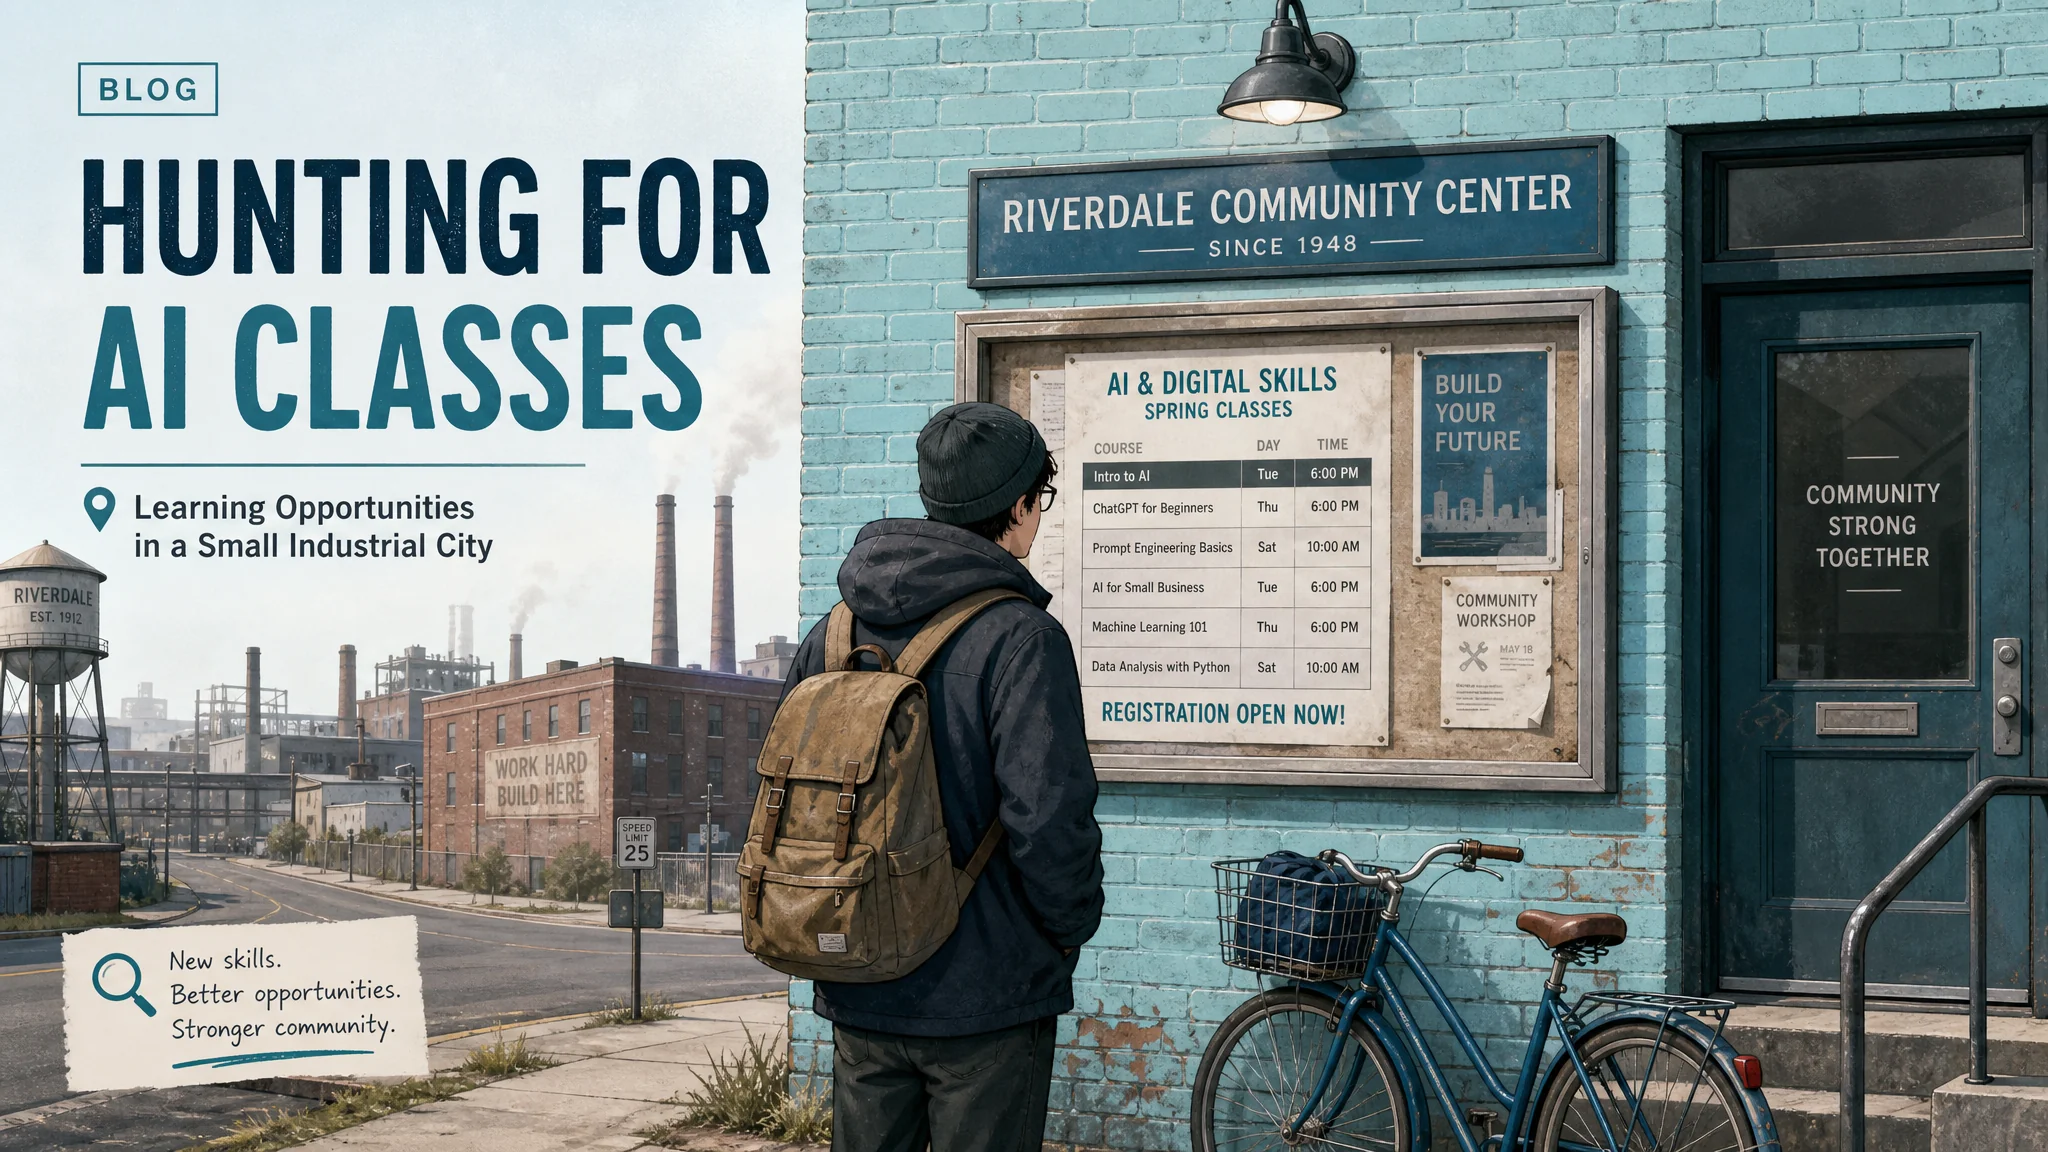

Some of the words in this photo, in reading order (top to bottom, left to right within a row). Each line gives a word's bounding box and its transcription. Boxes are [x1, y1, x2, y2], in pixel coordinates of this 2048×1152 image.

[1003, 190, 1194, 235] RIVERDALE
[1210, 180, 1423, 224] COMMUNITY
[1435, 173, 1572, 214] CENTER
[1208, 238, 1283, 258] SINCE
[1296, 234, 1358, 255] 1948
[1107, 373, 1129, 396] AI
[1137, 371, 1153, 395] &
[1162, 368, 1250, 394] DIGITAL
[1258, 366, 1338, 391] SKILLS
[1435, 373, 1502, 395] BUILD
[1144, 402, 1210, 420] SPRING
[1216, 399, 1293, 418] CLASSES
[1435, 402, 1496, 423] YOUR
[1094, 442, 1143, 455] COURSE
[1256, 439, 1281, 451] DAY
[1317, 438, 1348, 451] TIME
[1435, 430, 1521, 452] FUTURE
[1094, 470, 1121, 482] Intro
[1123, 471, 1135, 482] to
[1138, 470, 1150, 482] AI
[1257, 468, 1279, 480] Tue
[1310, 467, 1337, 479] 6:00
[1341, 467, 1359, 479] PM
[1806, 483, 1941, 504] COMMUNITY
[1093, 502, 1138, 514] ChatGPT
[1142, 502, 1156, 513] for
[1160, 502, 1214, 516] Beginners
[1257, 501, 1278, 513] Thu
[1311, 500, 1337, 512] 6:00
[1341, 500, 1359, 512] PM
[1829, 515, 1916, 536] STRONG
[1092, 543, 1131, 556] Prompt
[1134, 542, 1196, 556] Engineering
[1199, 541, 1233, 554] Basics
[1258, 541, 1276, 553] Sat
[1307, 540, 1338, 552] 10:00
[1341, 540, 1360, 552] AM
[1816, 547, 1930, 567] TOGETHER
[1092, 582, 1103, 593] AI
[1107, 582, 1121, 593] for
[1125, 582, 1153, 593] Small
[1158, 582, 1204, 593] Business
[1257, 581, 1278, 593] Tue
[1311, 581, 1337, 592] 6:00
[1341, 581, 1359, 592] PM
[14, 587, 93, 607] RIVERDALE
[1456, 593, 1538, 607] COMMUNITY
[30, 611, 55, 623] EST.
[60, 612, 83, 624] 1912
[1457, 613, 1536, 627] WORKSHOP
[1092, 621, 1136, 633] Machine
[1140, 621, 1186, 635] Learning
[1190, 621, 1207, 633] 101
[1257, 621, 1278, 633] Thu
[1310, 621, 1337, 633] 6:00
[1341, 621, 1359, 633] PM
[1500, 644, 1519, 654] MAY
[1523, 644, 1533, 654] 18
[1092, 661, 1116, 673] Data
[1120, 661, 1163, 674] Analysis
[1167, 661, 1189, 673] with
[1193, 661, 1230, 675] Python
[1257, 662, 1276, 673] Sat
[1307, 662, 1338, 673] 10:00
[1342, 662, 1360, 674] AM
[1102, 701, 1229, 723] REGISTRATION
[1237, 703, 1285, 724] OPEN
[1294, 704, 1345, 725] NOW!
[495, 756, 539, 779] WORK
[545, 750, 588, 775] HARD
[497, 784, 539, 807] BUILD
[545, 780, 585, 805] HERE
[622, 823, 652, 832] SPEED
[626, 834, 648, 842] LIMIT
[624, 845, 649, 862] 25
